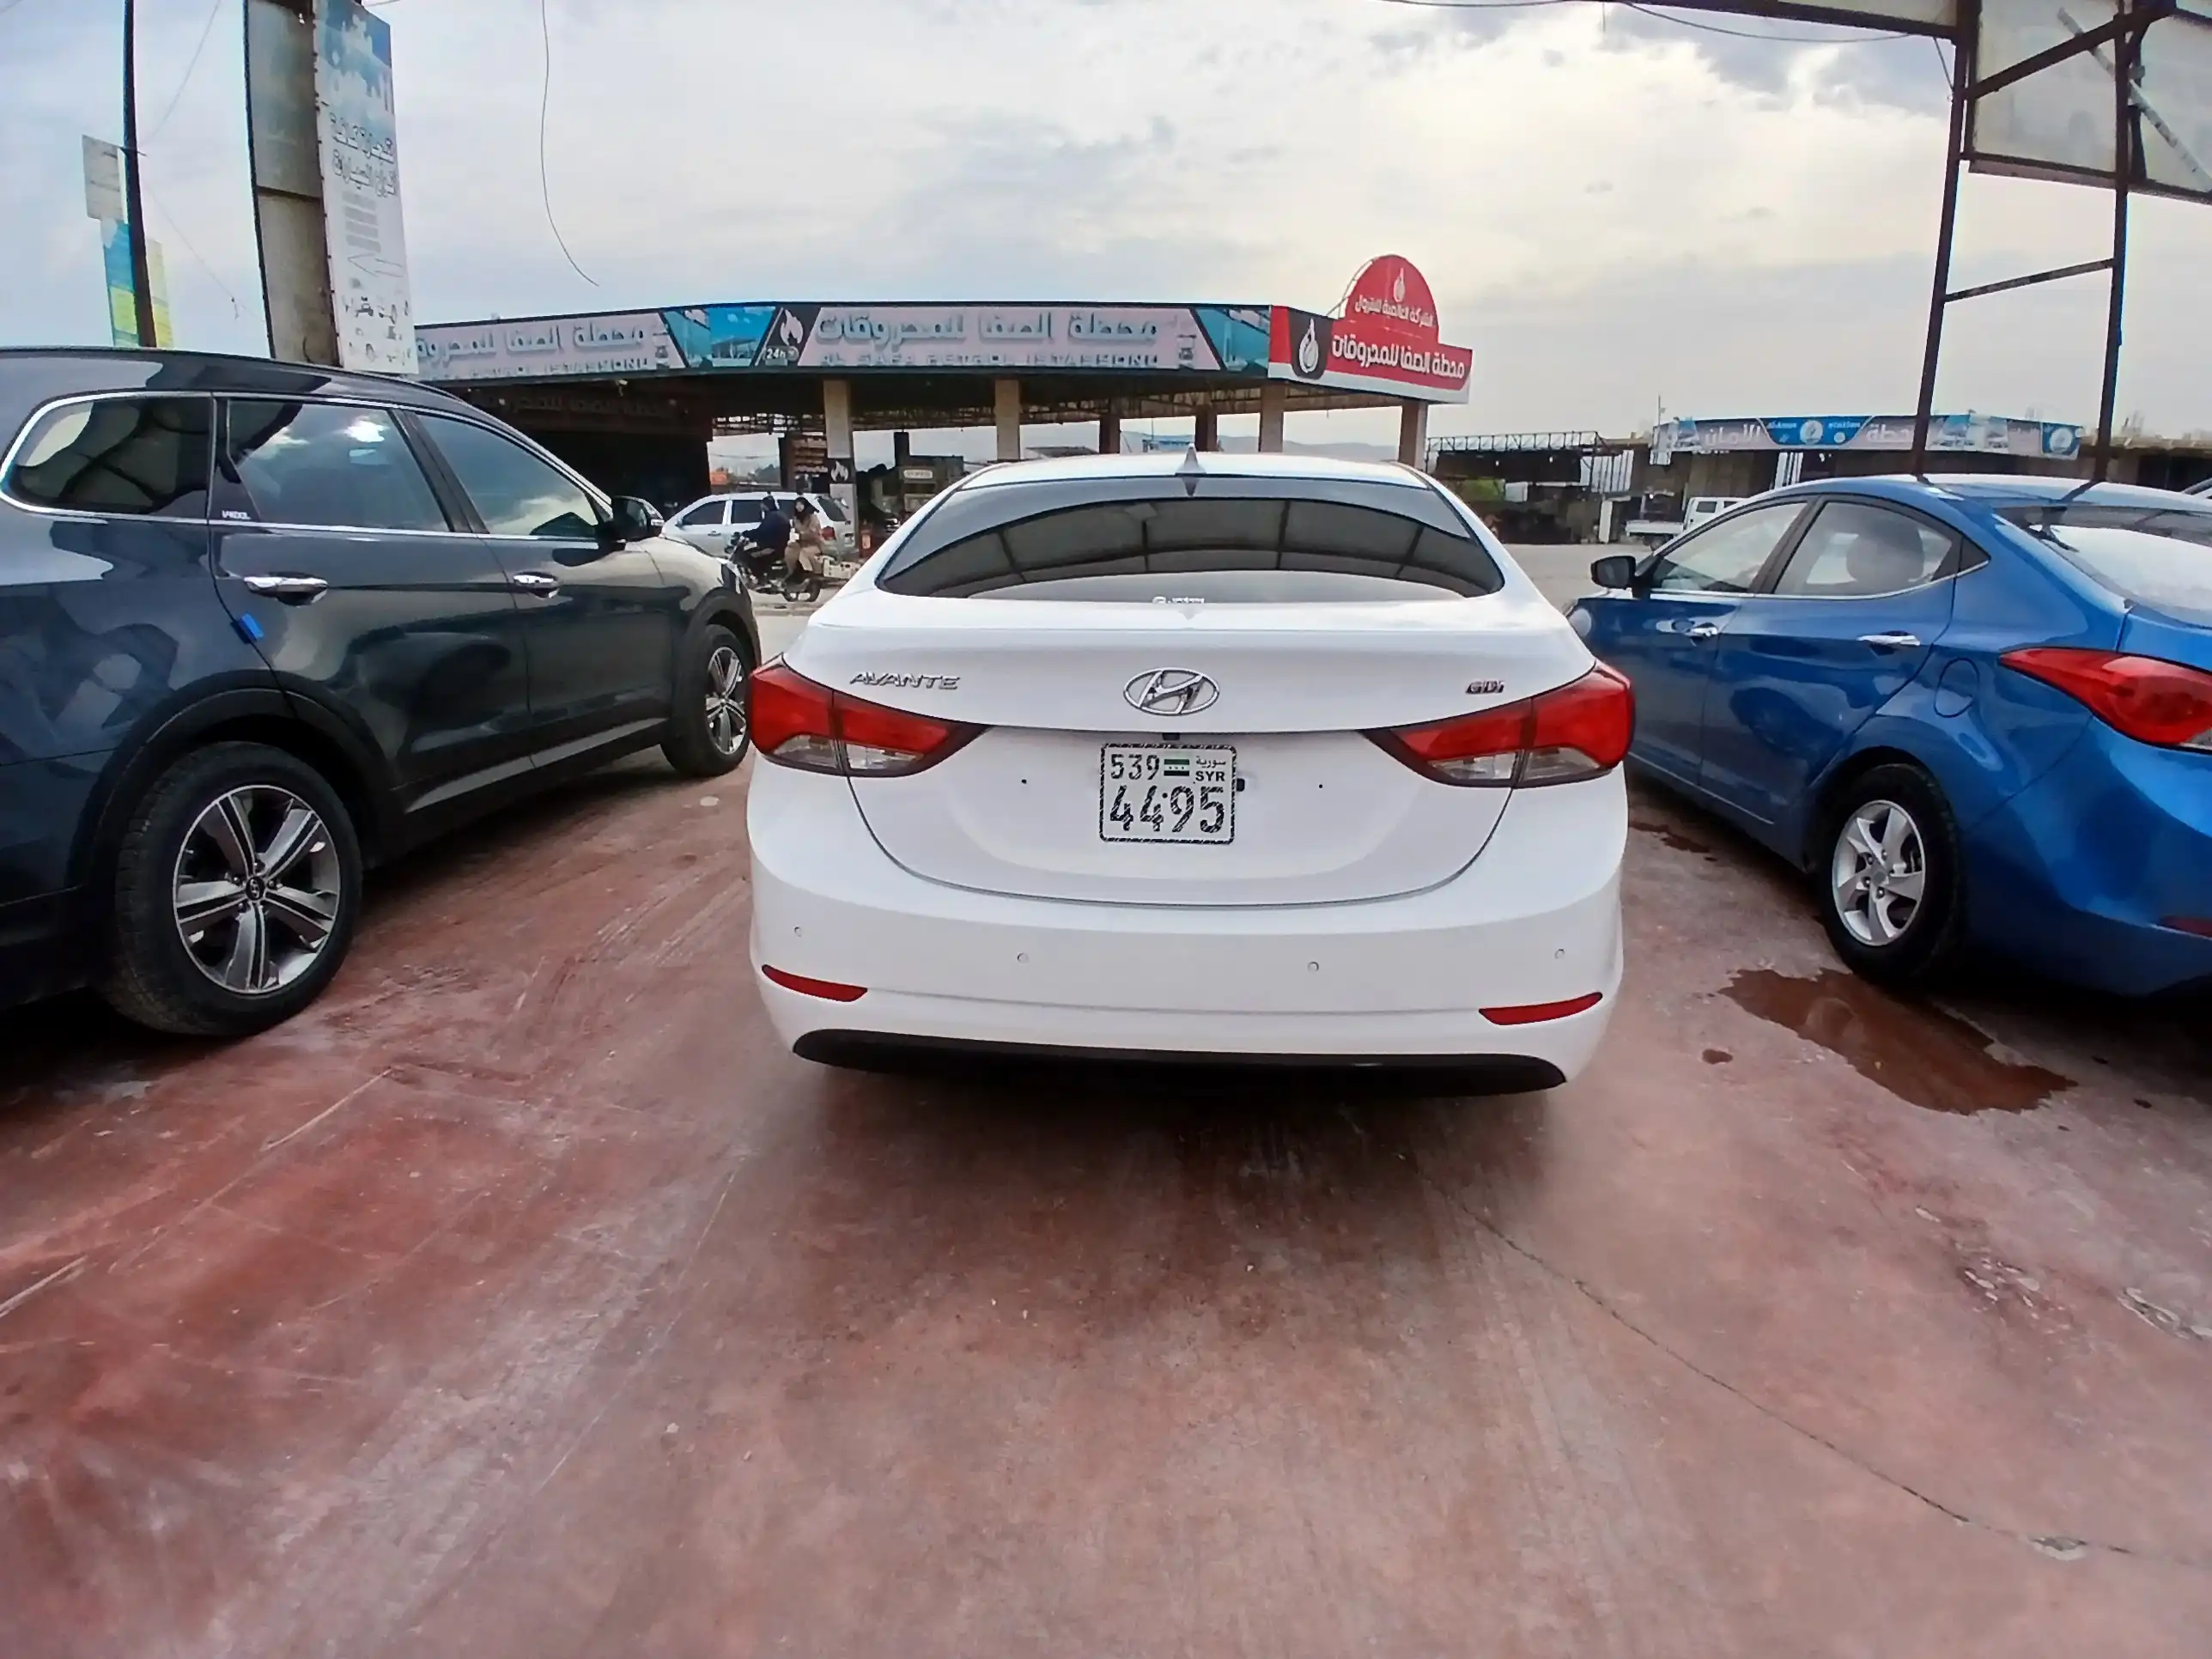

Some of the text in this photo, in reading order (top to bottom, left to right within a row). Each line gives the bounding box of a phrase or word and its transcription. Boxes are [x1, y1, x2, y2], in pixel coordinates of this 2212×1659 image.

[504, 325, 563, 354] الصفا
[571, 322, 645, 348] محطة
[817, 311, 1158, 351] محطة الصفا للمحروقات
[416, 331, 496, 368] للمحروق
[1332, 334, 1465, 379] محطة الصفا للمحروقات
[849, 671, 961, 690] AVANTE
[1110, 753, 1160, 781] 539
[1195, 770, 1225, 782] SYR
[1196, 756, 1226, 769] سورية
[1109, 785, 1225, 834] 4495
